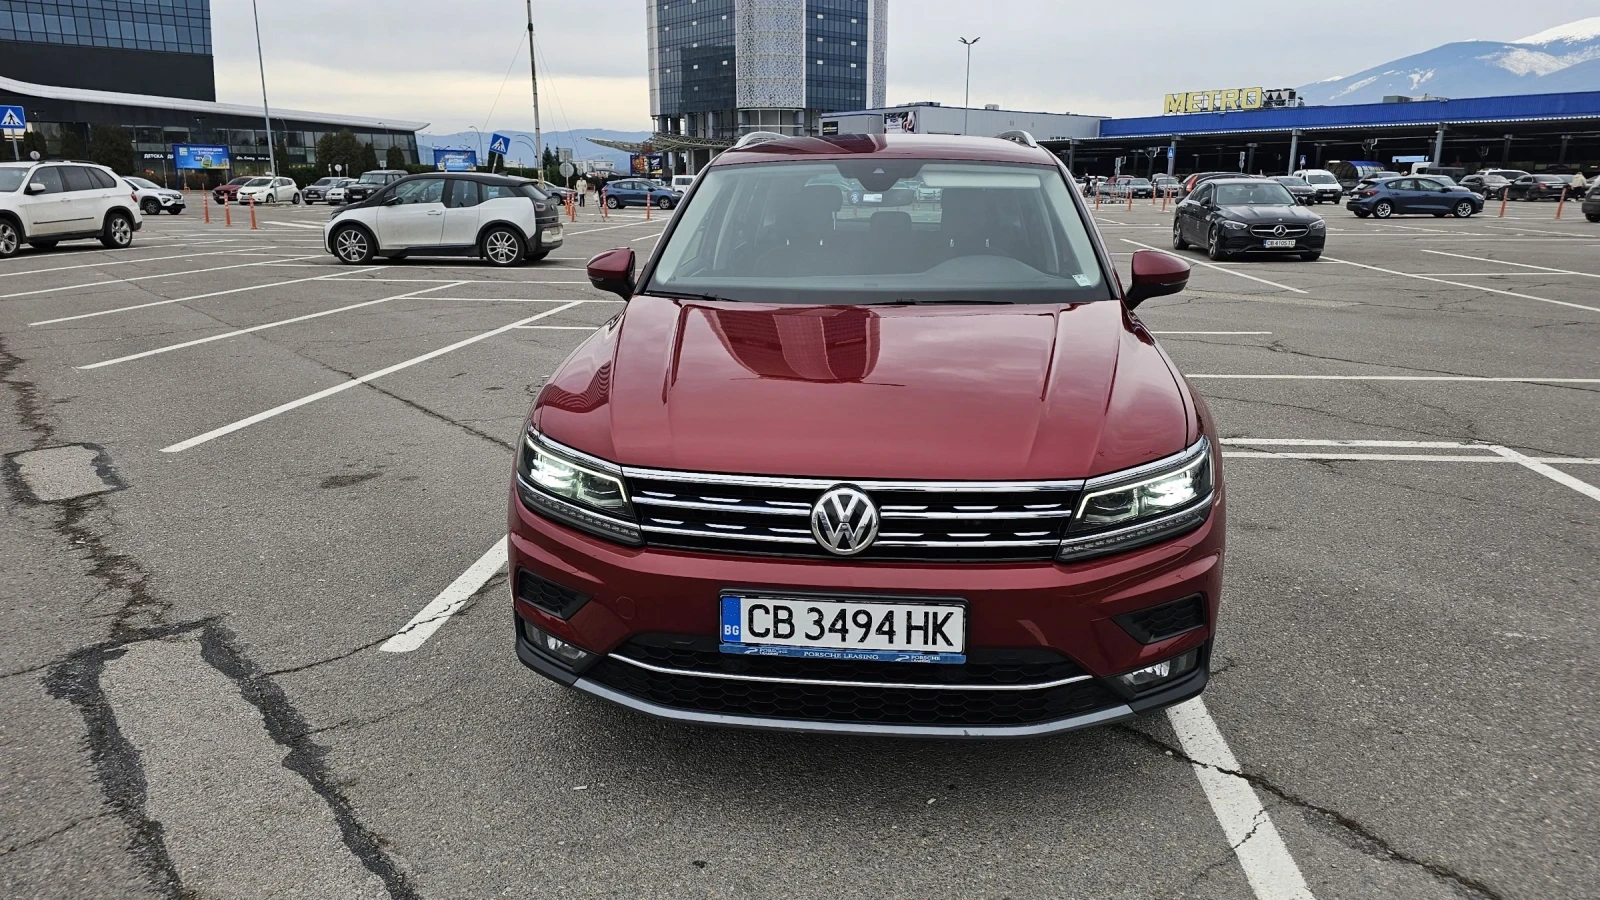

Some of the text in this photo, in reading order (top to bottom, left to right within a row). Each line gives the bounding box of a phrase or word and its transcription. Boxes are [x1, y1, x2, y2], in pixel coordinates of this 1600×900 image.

[1163, 87, 1263, 114] METRO
[811, 487, 879, 555] VW
[724, 624, 740, 636] BG
[747, 604, 955, 647] CB 3494 HK
[803, 651, 842, 659] PORSCHE
